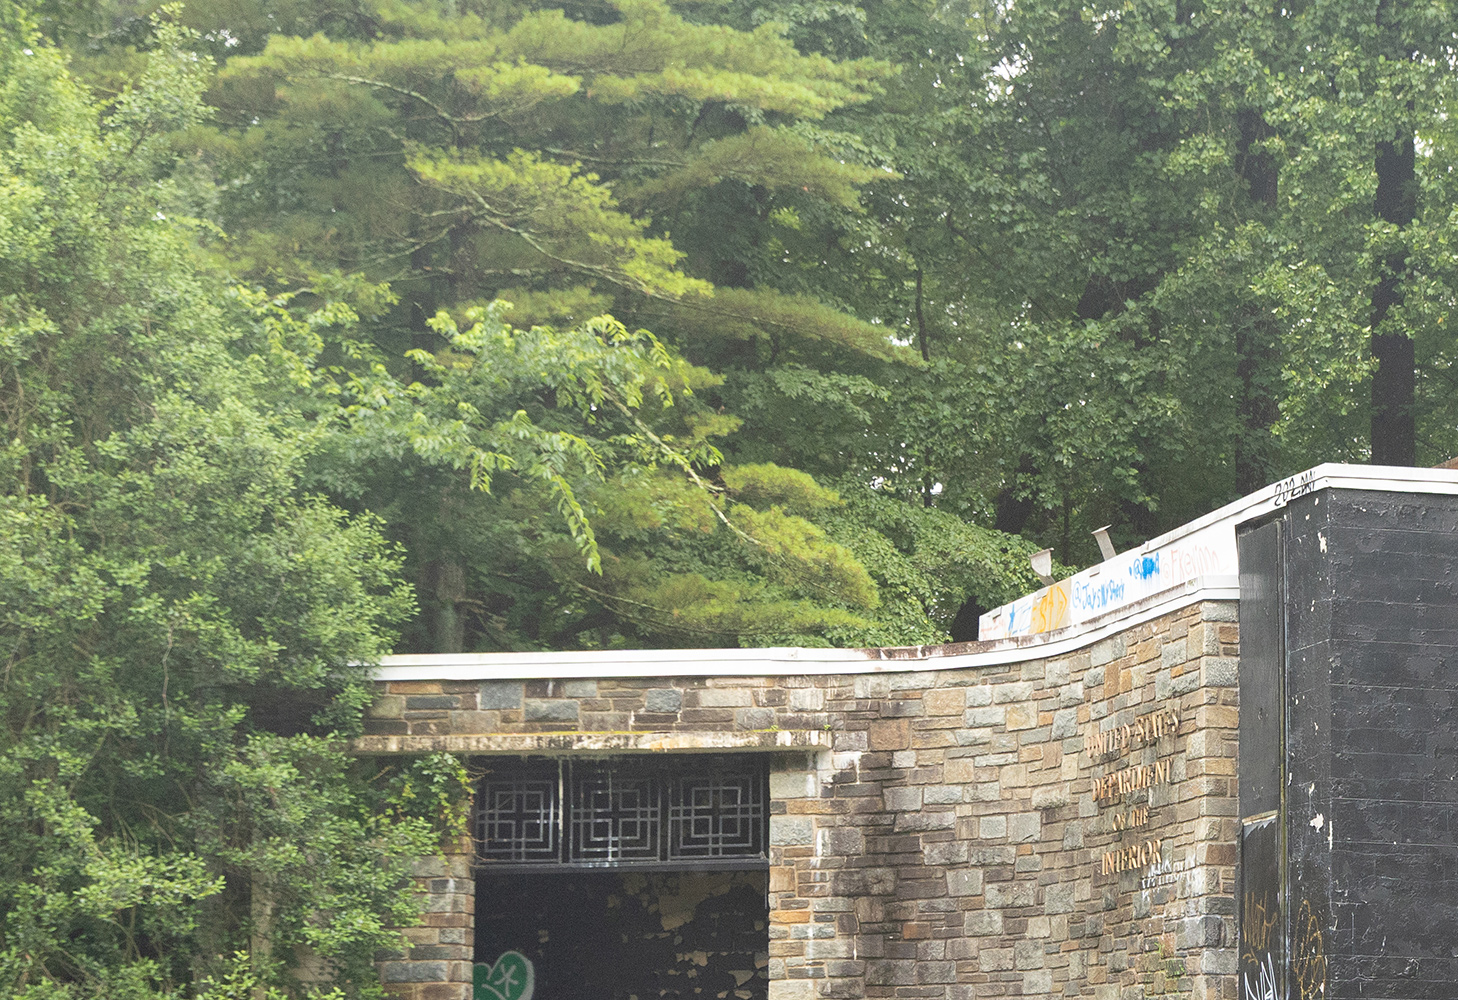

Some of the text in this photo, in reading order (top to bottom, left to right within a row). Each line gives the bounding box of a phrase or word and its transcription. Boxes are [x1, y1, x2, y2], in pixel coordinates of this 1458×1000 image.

[1085, 707, 1180, 758] UNITED STATES
[1092, 757, 1174, 801] DEPARTMENT
[1131, 806, 1150, 828] THE
[1101, 838, 1162, 876] INTERIOR
